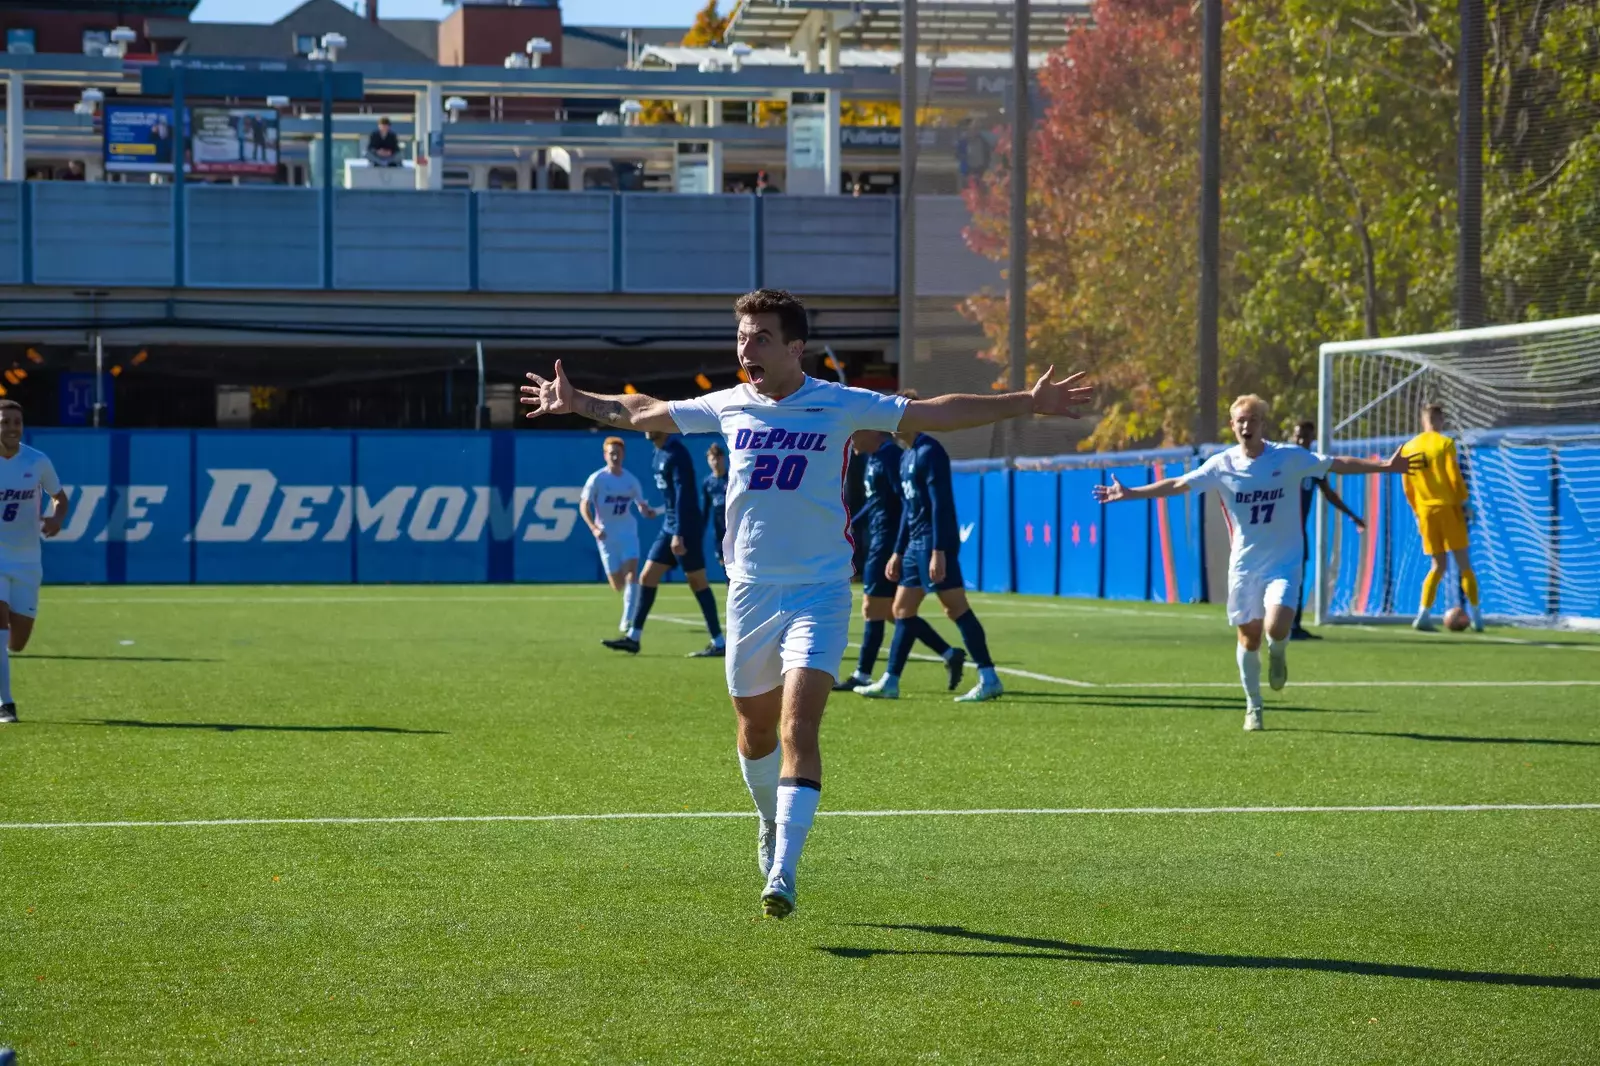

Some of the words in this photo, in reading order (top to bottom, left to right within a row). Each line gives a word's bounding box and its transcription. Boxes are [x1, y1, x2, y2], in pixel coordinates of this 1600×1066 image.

[735, 428, 828, 451] DEPAUL
[748, 454, 809, 491] 20
[2, 503, 19, 522] 6
[41, 484, 169, 542] UE
[184, 469, 585, 542] DEMONS
[1249, 503, 1275, 525] 17
